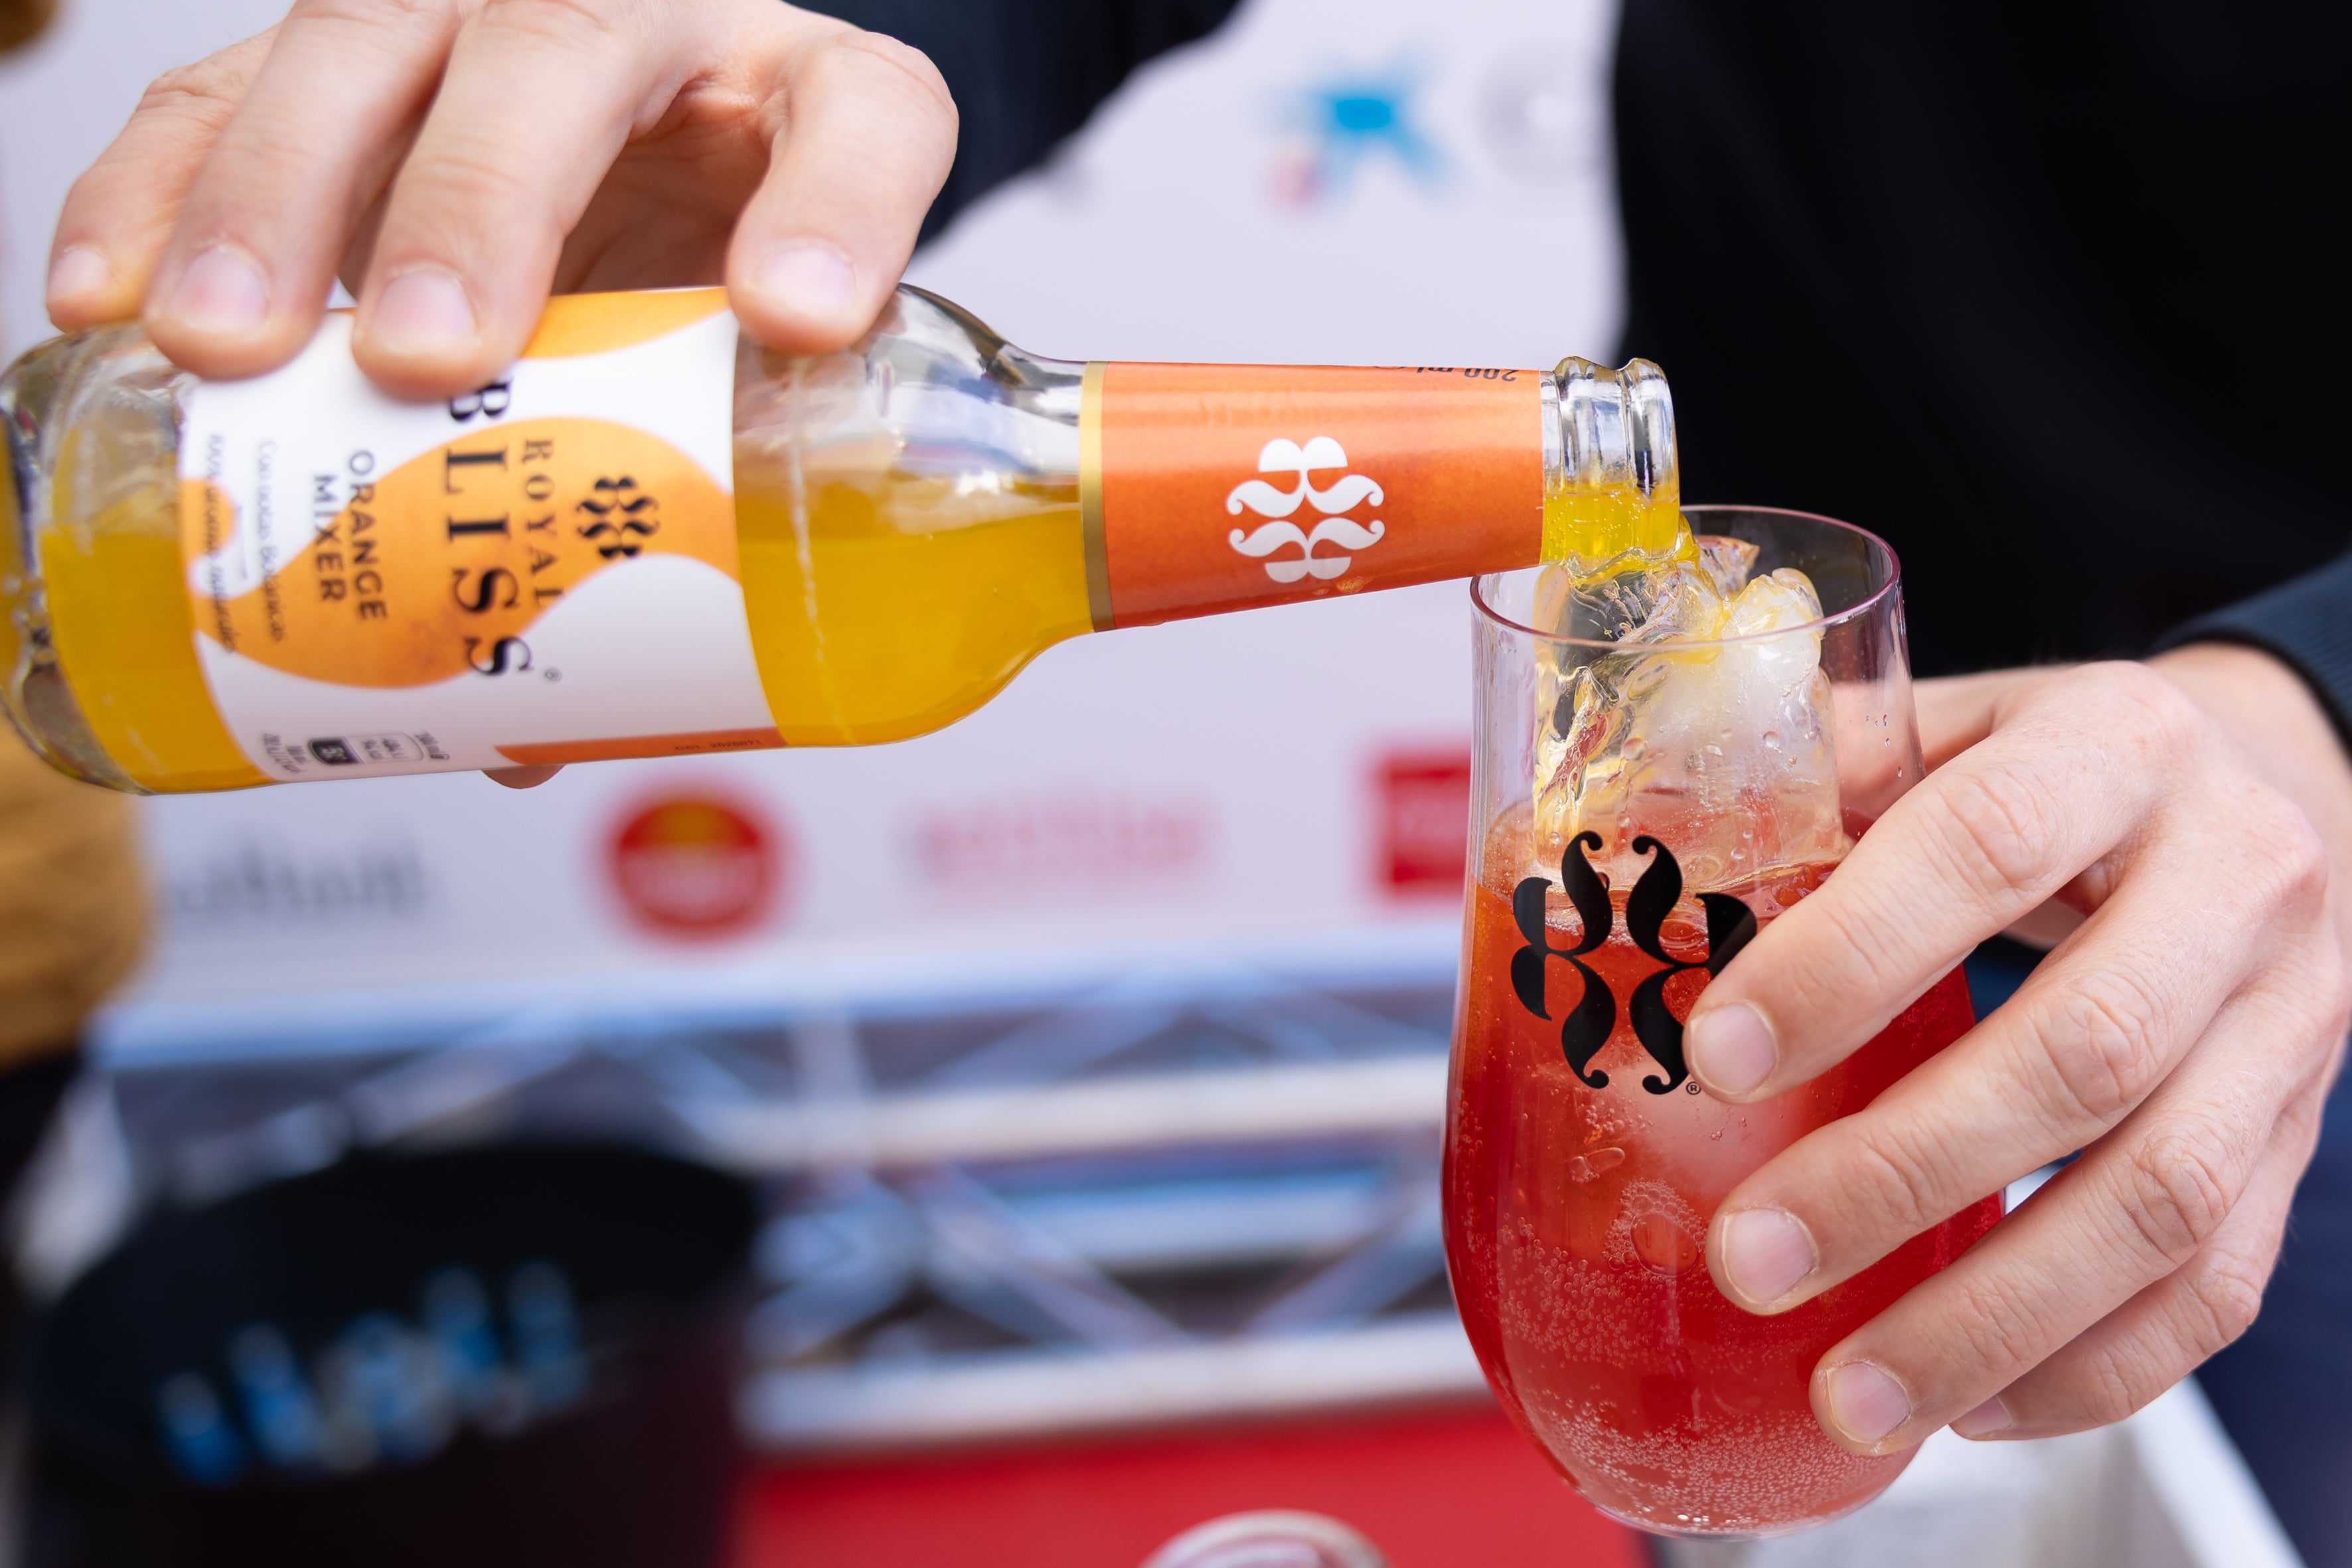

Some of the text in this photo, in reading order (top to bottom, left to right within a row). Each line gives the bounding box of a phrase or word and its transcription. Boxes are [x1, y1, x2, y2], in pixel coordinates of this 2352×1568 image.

[313, 473, 348, 603] MIXER
[349, 449, 389, 623] ORANGE
[445, 379, 533, 678] BLISS
[522, 437, 565, 608] ROYAL
